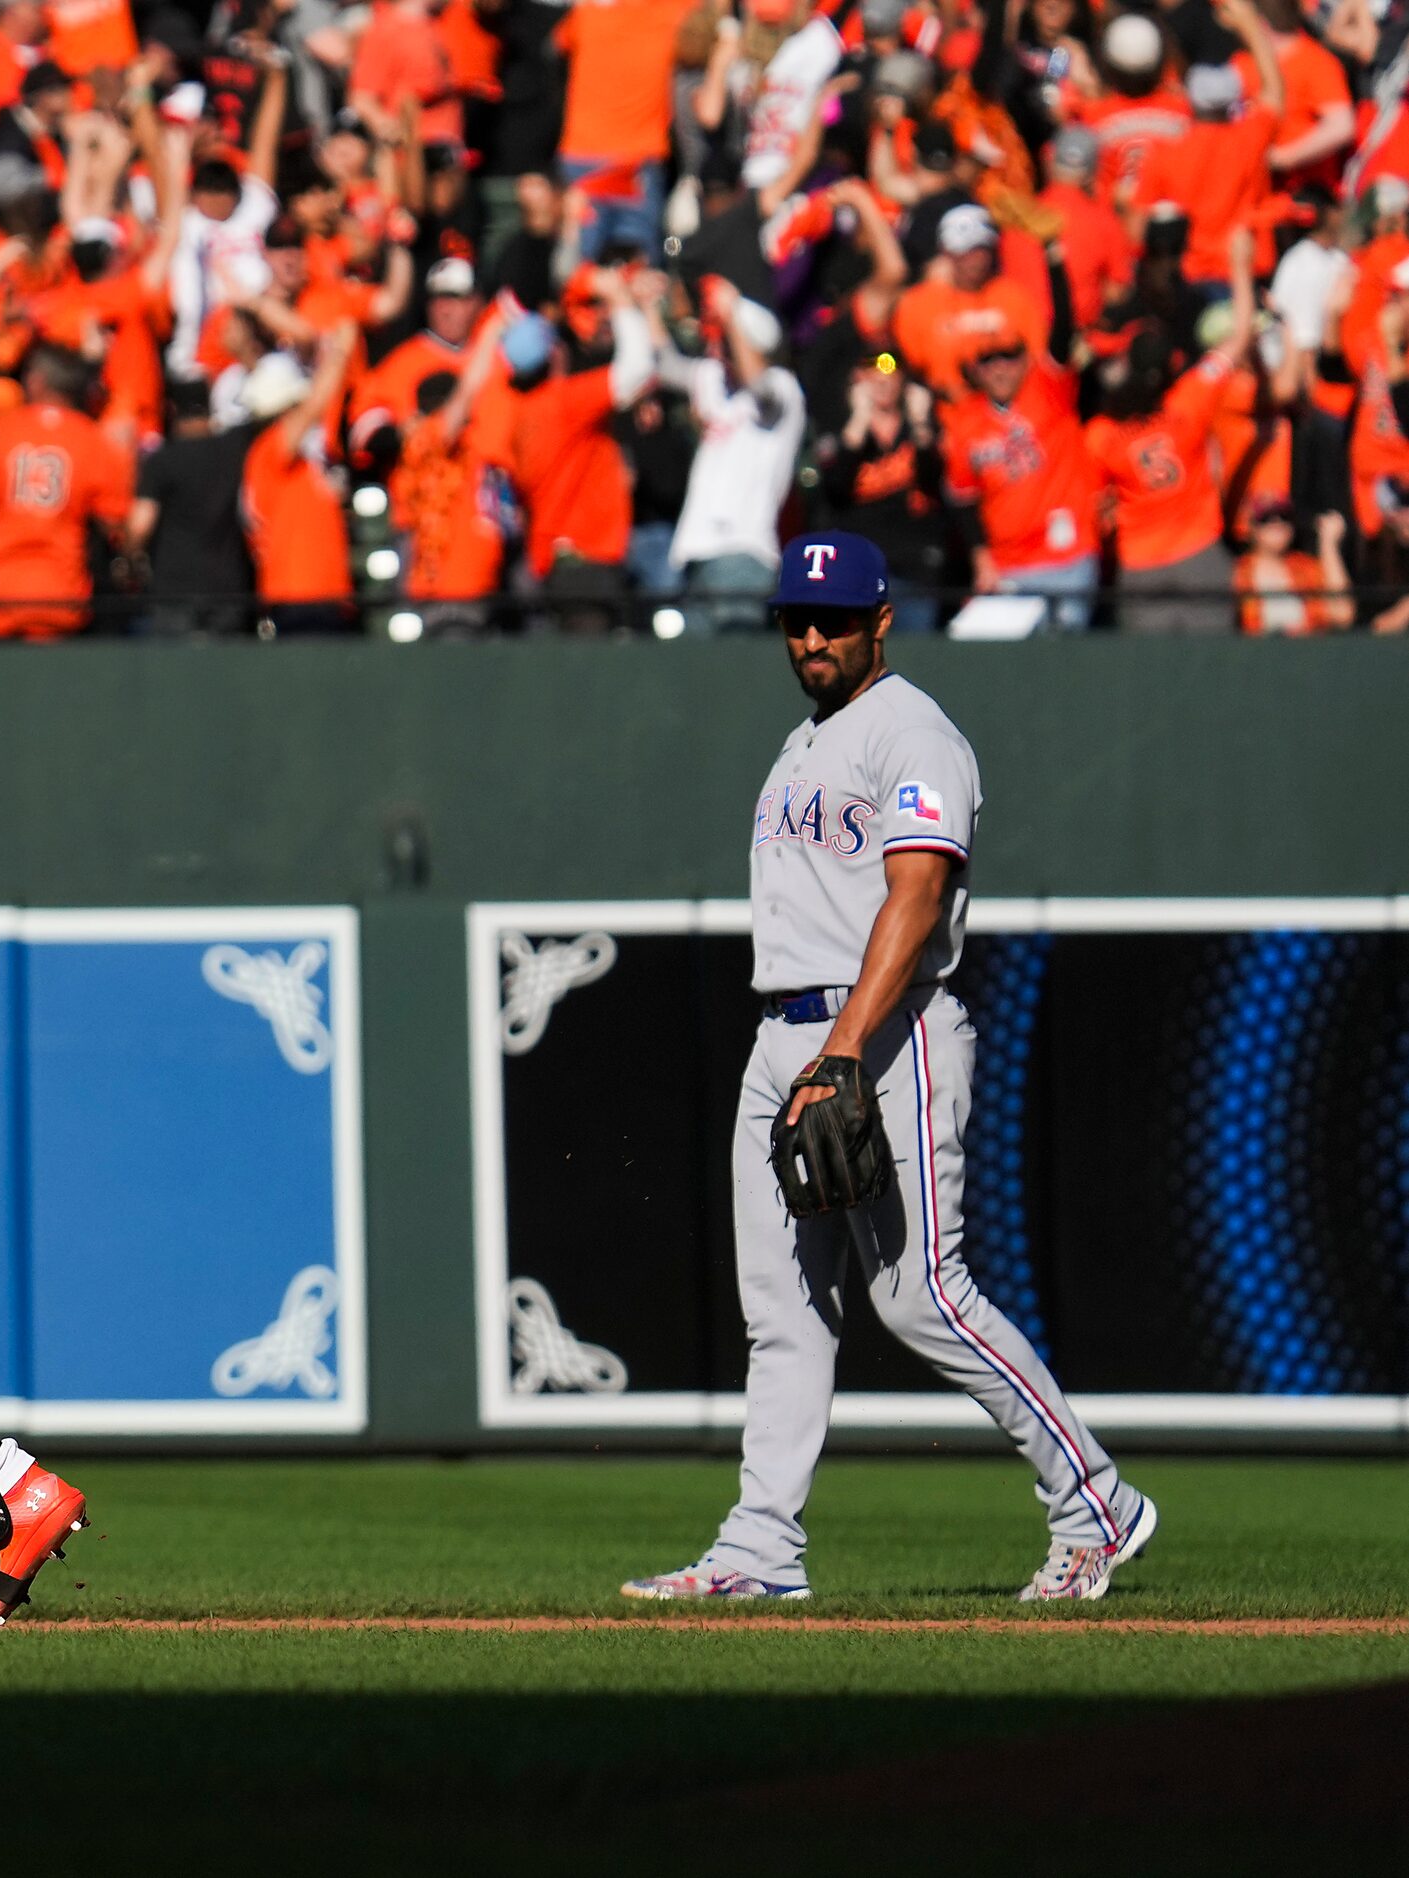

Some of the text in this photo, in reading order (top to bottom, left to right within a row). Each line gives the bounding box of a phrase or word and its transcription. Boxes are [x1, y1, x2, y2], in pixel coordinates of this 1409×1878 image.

[10, 443, 69, 514] 13
[1133, 434, 1183, 492] 5
[803, 544, 838, 582] T
[754, 779, 875, 858] EXAS
